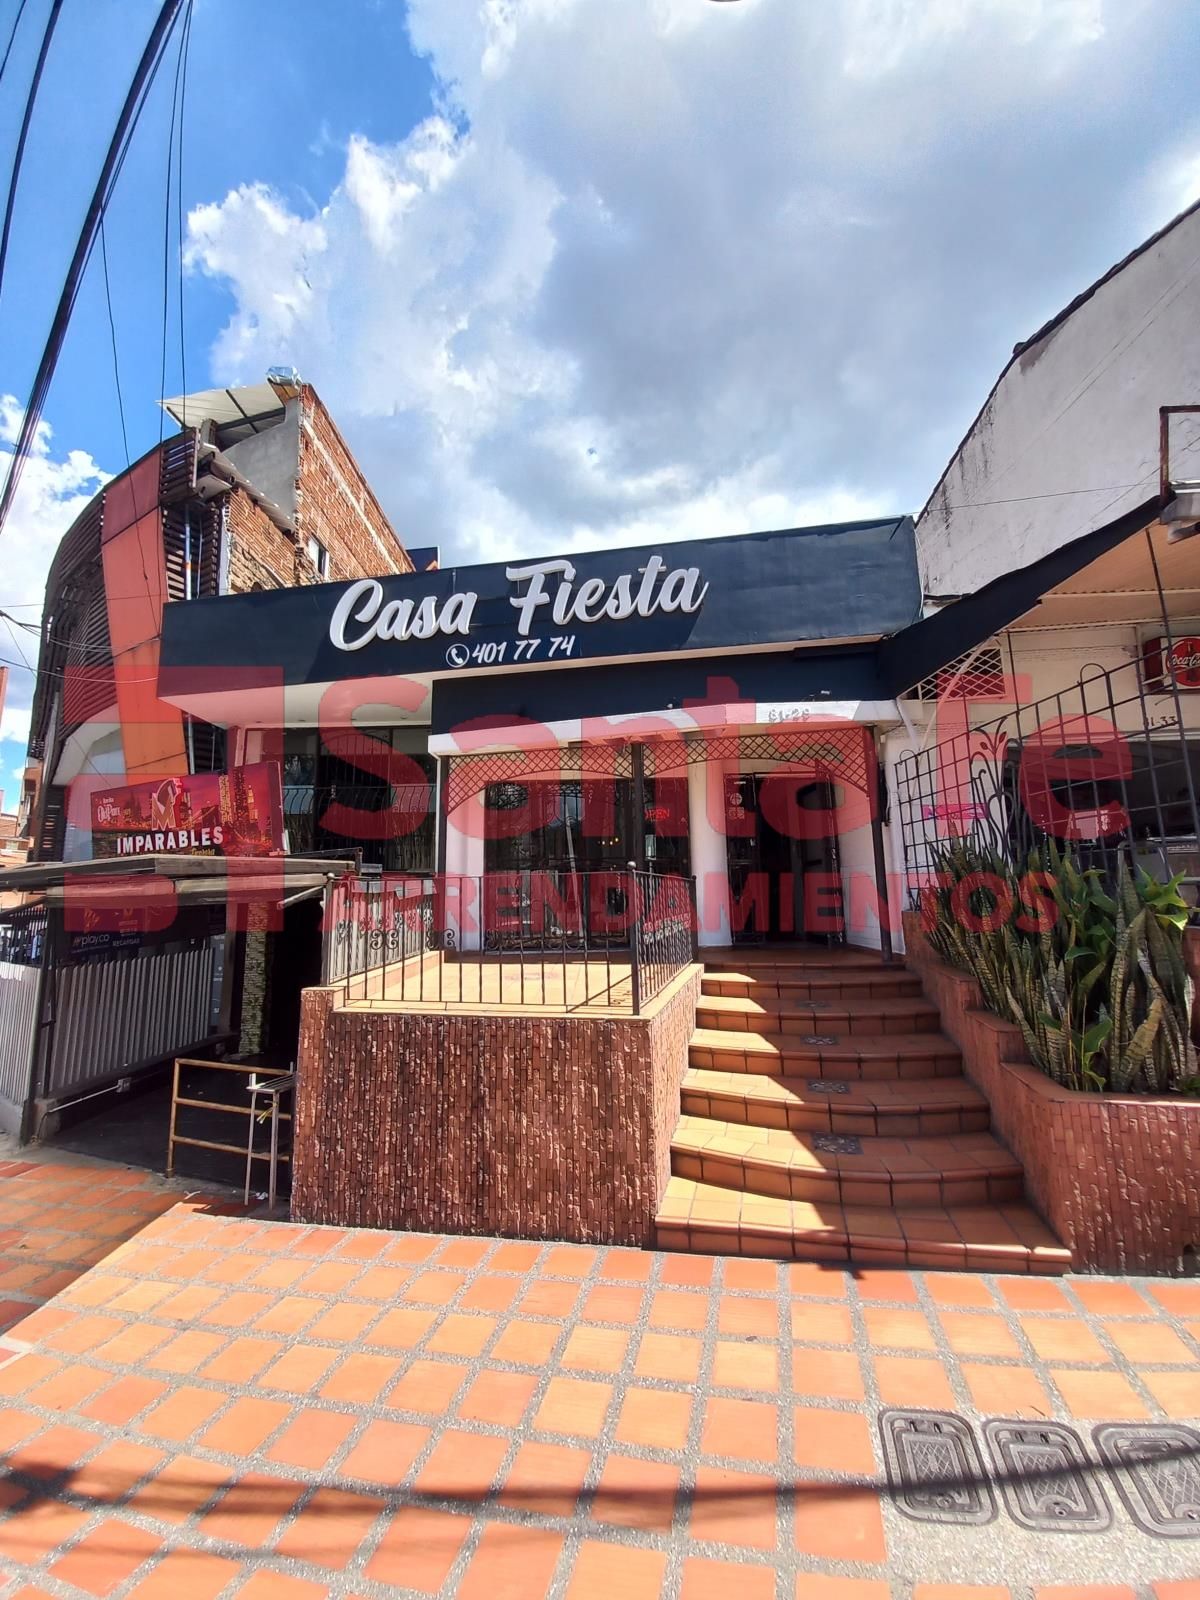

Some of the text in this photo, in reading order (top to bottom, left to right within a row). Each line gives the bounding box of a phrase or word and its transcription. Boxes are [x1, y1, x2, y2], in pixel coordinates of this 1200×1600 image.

[329, 555, 709, 652] Casa Fiesta
[472, 634, 576, 664] 401 77 74
[117, 826, 224, 855] IMPARABLES
